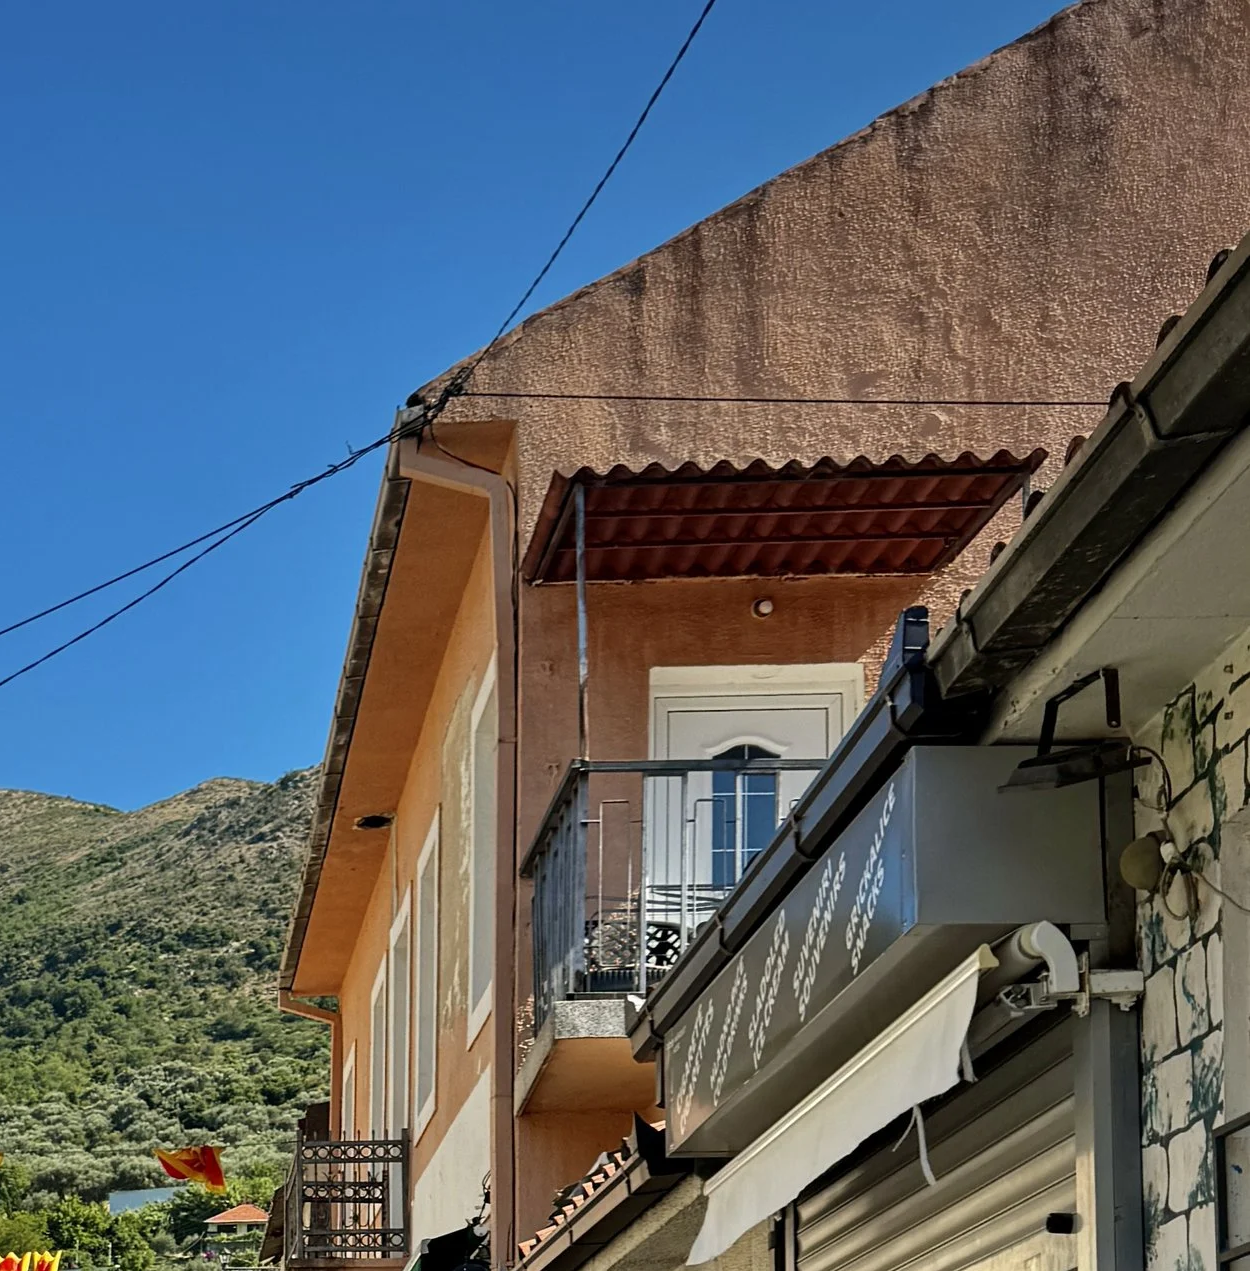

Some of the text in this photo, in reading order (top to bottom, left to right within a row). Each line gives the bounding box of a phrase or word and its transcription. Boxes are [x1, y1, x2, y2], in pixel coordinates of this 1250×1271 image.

[792, 858, 833, 998] SUVENIRI
[845, 782, 897, 949] GRICKALICE
[851, 865, 884, 975] SNACKS
[747, 908, 786, 1048] SLADOLED
[753, 931, 791, 1069] ICE CREAM
[798, 853, 846, 1022] SOUVENIRS
